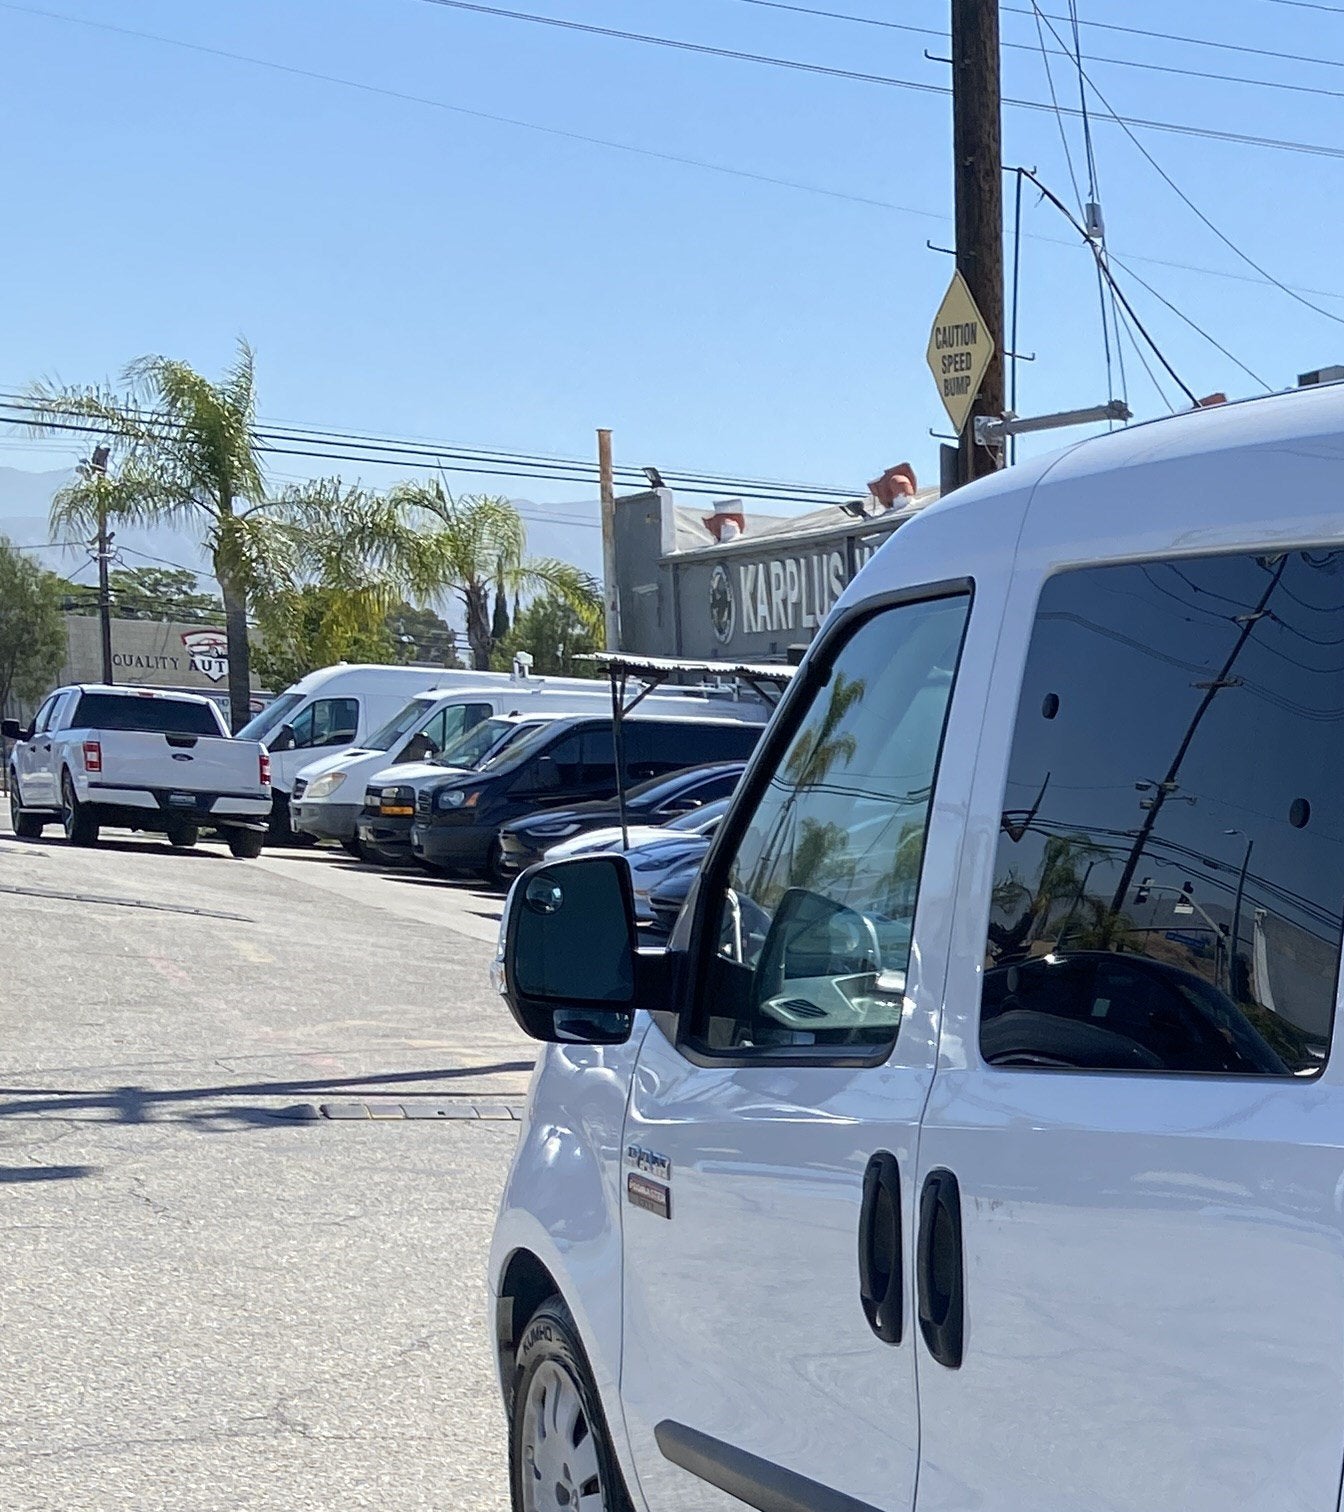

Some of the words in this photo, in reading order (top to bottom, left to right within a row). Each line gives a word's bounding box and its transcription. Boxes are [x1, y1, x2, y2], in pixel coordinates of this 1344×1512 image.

[935, 322, 977, 349] CAUTION
[942, 352, 972, 374] SPEED
[944, 375, 970, 397] BUMP
[740, 552, 844, 633] KARPLUS
[113, 654, 179, 670] QUALITY
[189, 659, 225, 672] AUT
